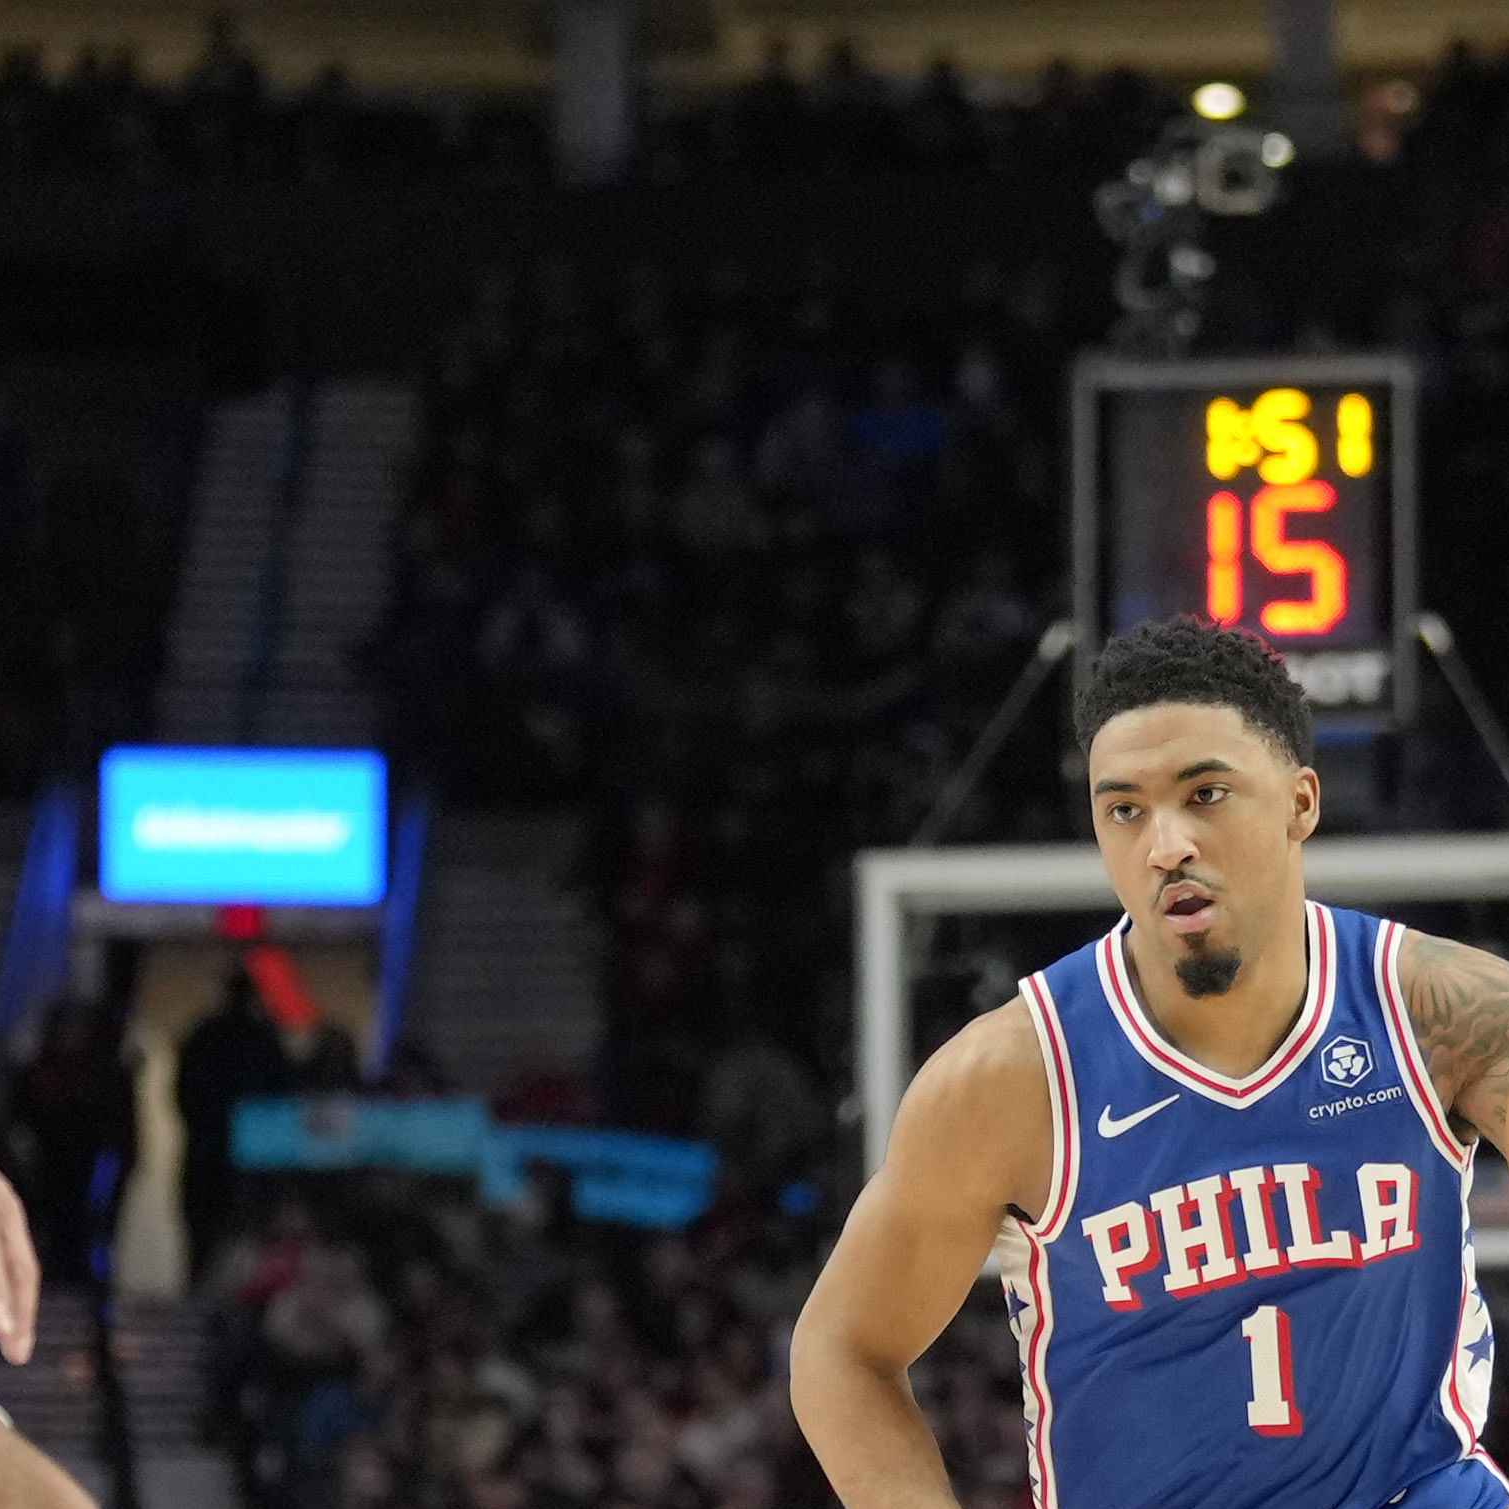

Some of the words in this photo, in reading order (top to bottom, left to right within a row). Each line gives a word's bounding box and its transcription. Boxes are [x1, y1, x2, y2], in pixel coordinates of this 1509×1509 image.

[1206, 480, 1349, 636] 15
[1309, 1086, 1402, 1118] crypto.com
[1081, 1163, 1421, 1311] PHILA
[1242, 1305, 1303, 1437] 1
